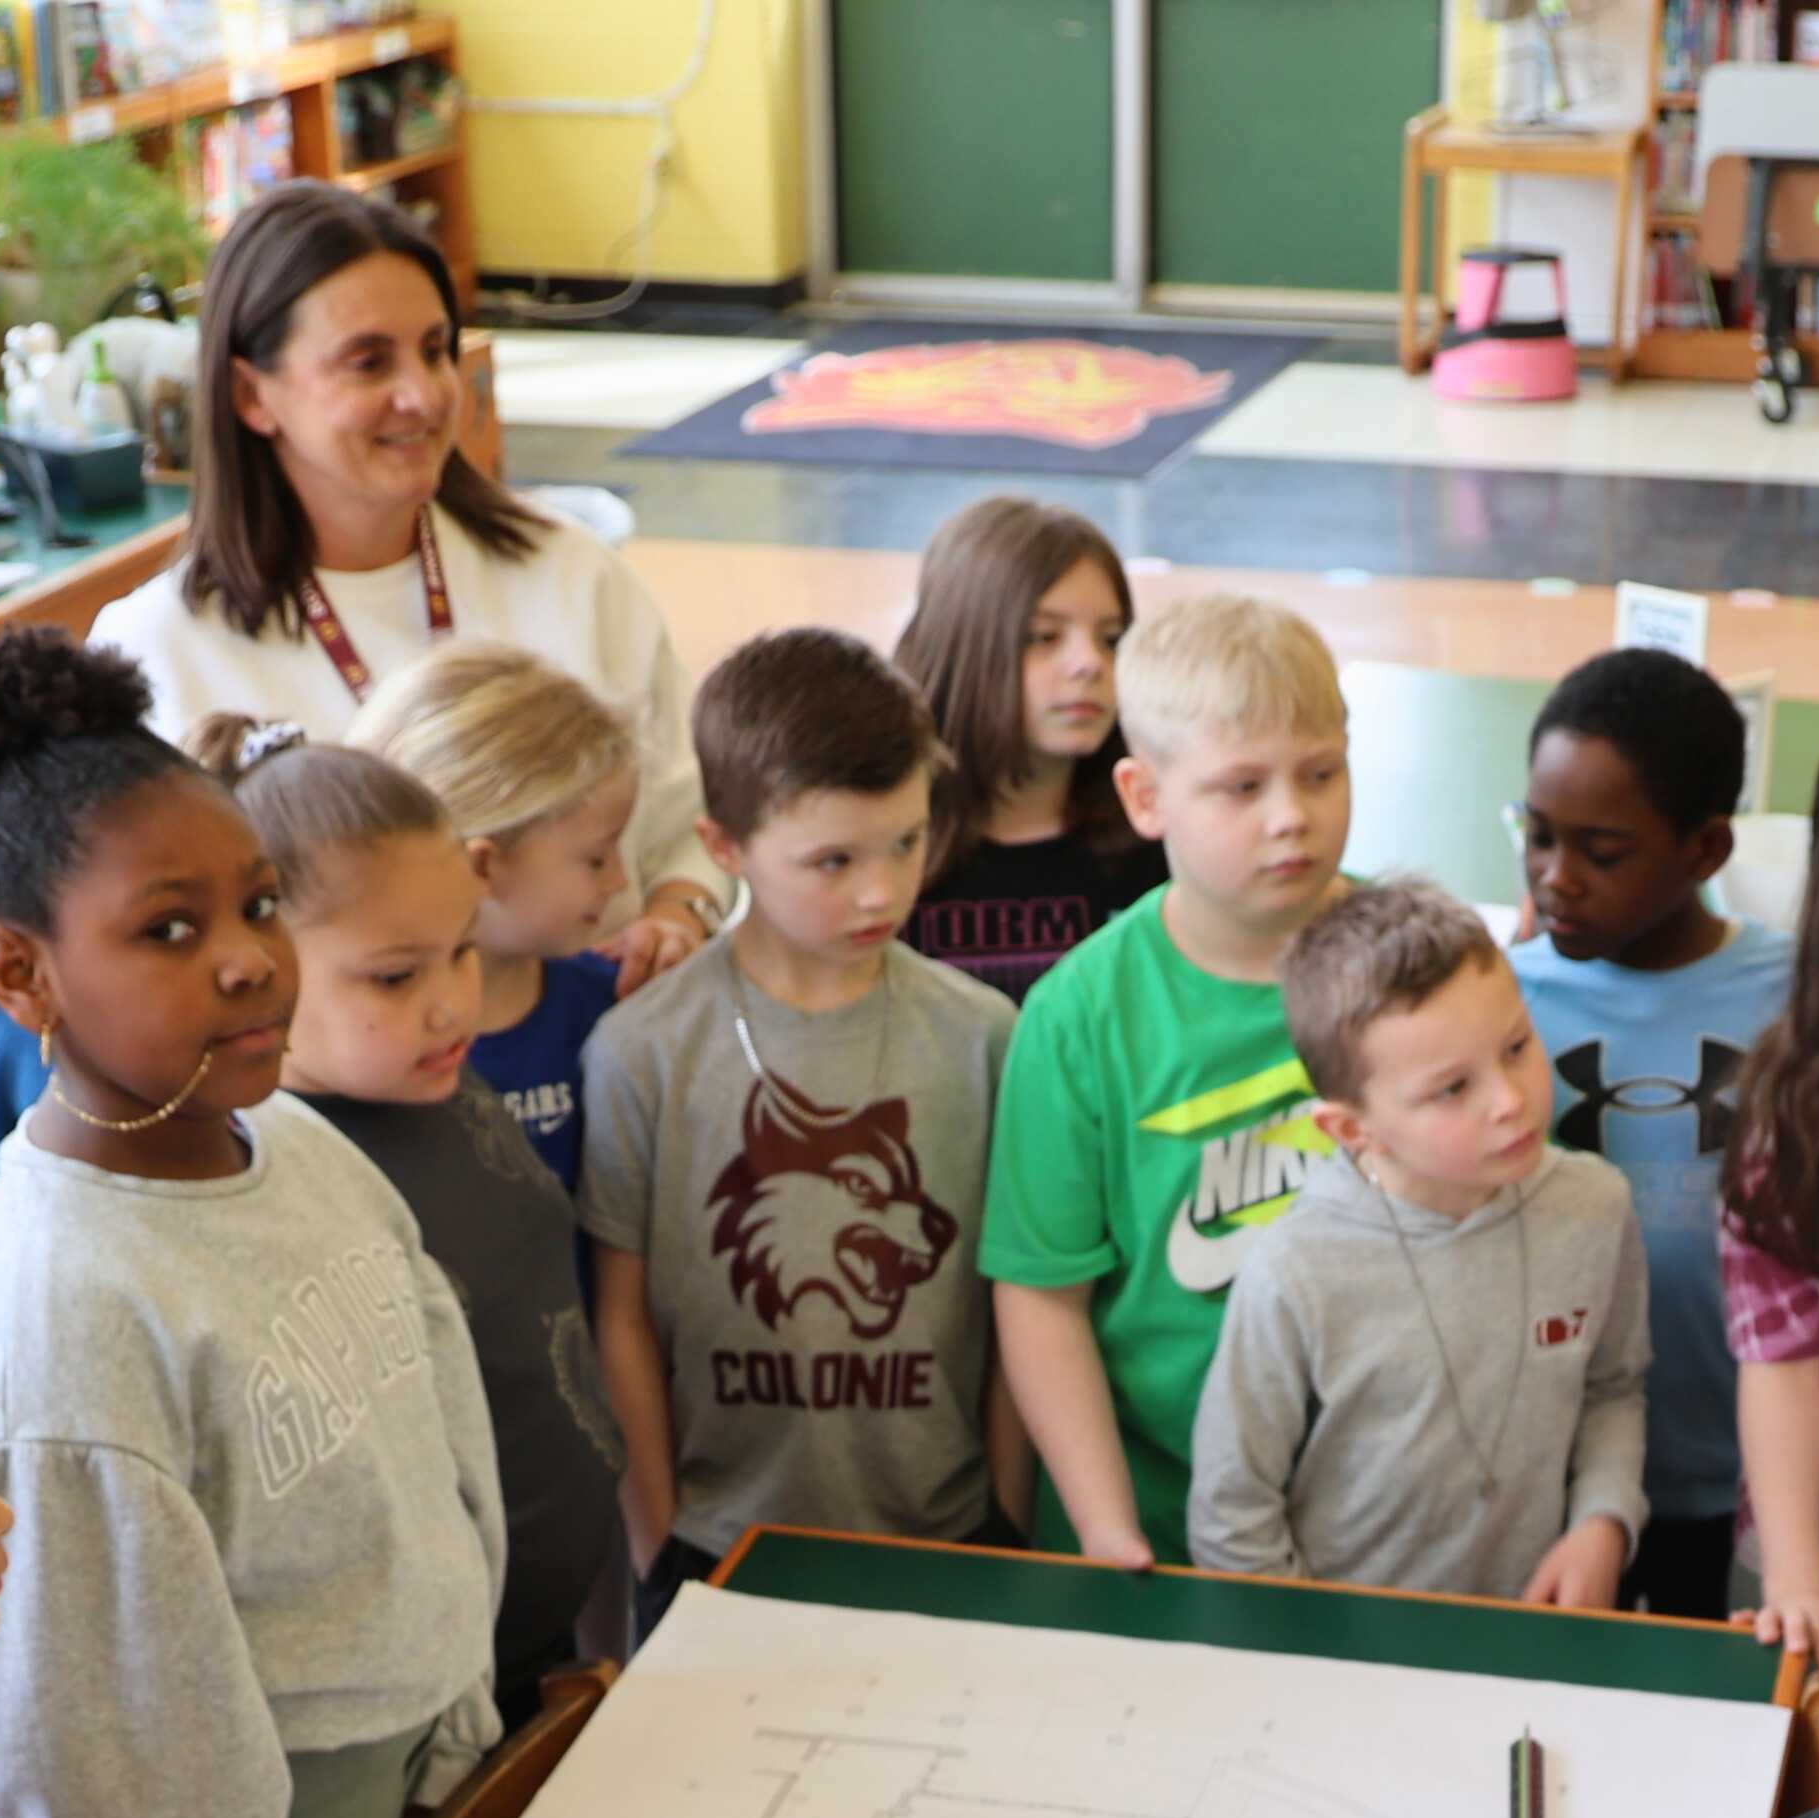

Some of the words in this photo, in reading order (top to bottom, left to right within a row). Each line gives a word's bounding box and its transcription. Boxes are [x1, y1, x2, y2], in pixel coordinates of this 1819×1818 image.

[1192, 1100, 1323, 1226] NIK
[245, 1273, 373, 1500] GAP
[710, 1352, 935, 1411] COLONIE
